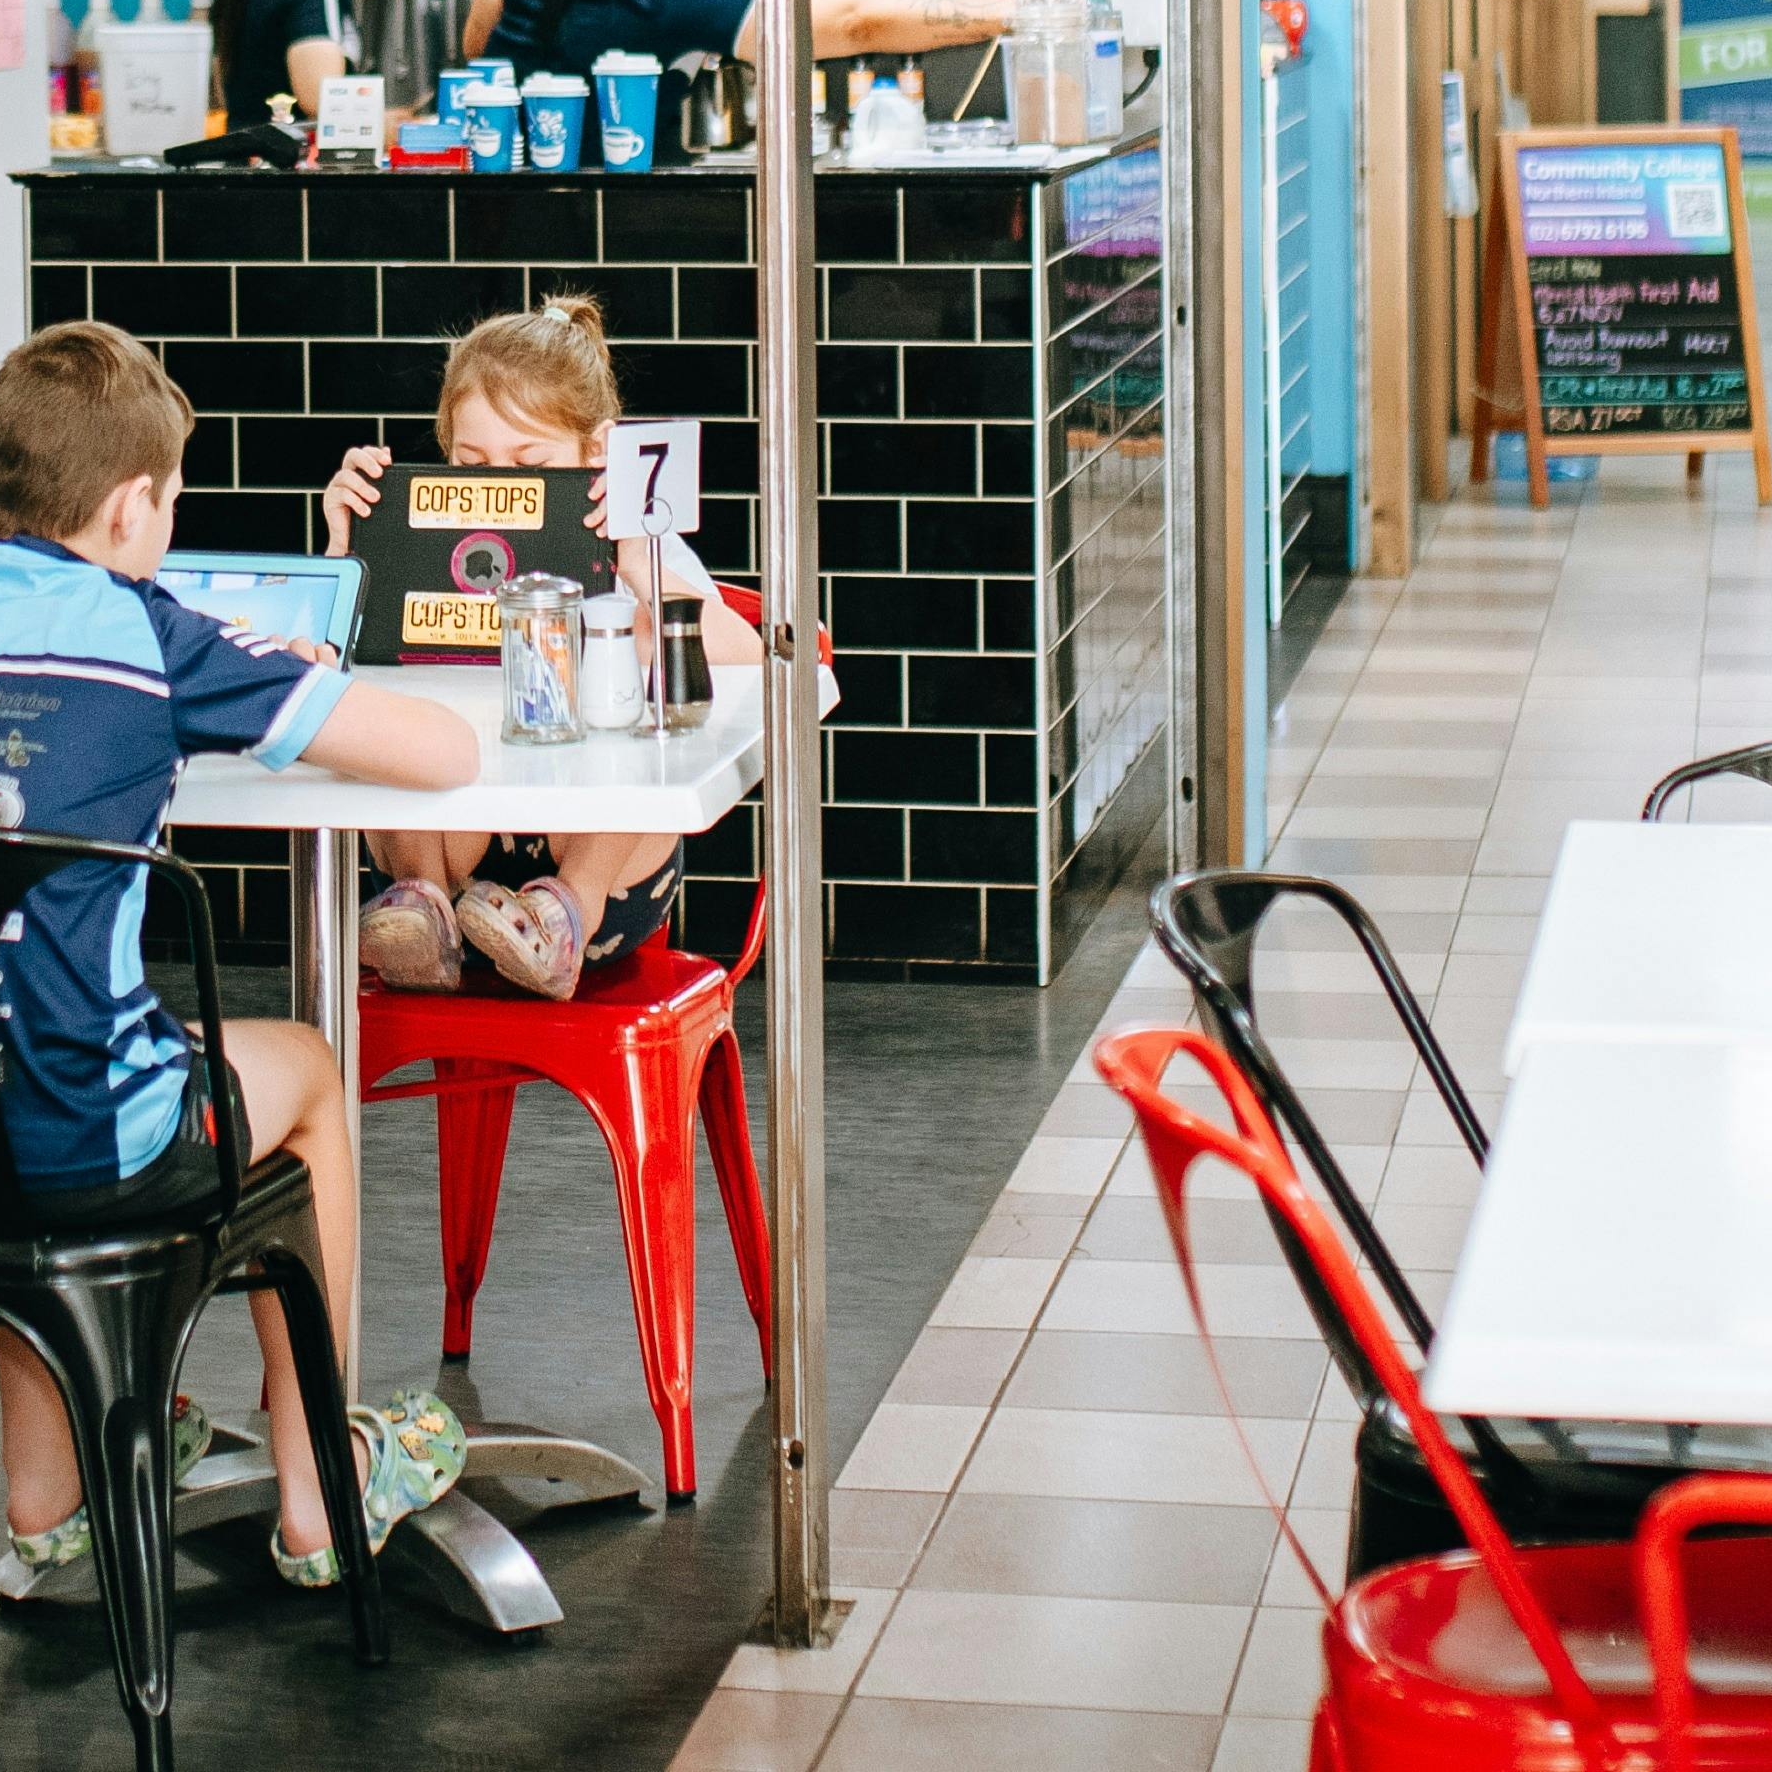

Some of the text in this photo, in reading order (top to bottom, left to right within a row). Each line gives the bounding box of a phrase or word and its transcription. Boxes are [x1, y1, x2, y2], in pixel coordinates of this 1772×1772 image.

[1699, 36, 1768, 75] FOR
[1524, 154, 1719, 182] Community College
[1686, 276, 1722, 305] Aid
[638, 441, 670, 516] 7
[416, 485, 538, 515] COPS TOPS
[410, 600, 468, 630] COPS
